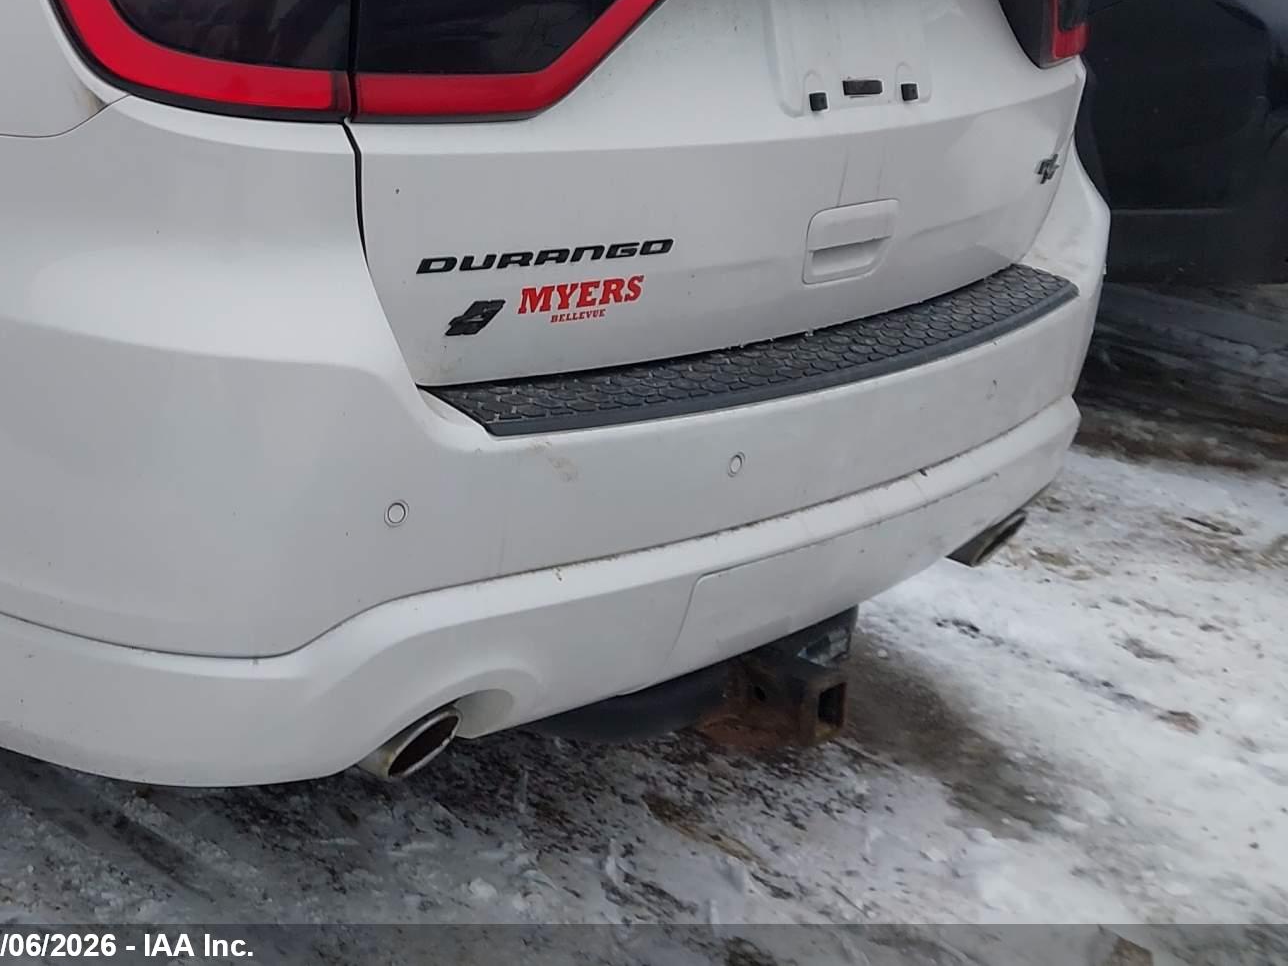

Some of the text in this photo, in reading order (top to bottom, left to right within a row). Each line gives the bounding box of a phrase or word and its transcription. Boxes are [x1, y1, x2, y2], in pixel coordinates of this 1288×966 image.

[416, 238, 673, 274] DURANGO
[518, 275, 644, 314] MYERS
[550, 308, 606, 323] BELLEVUE
